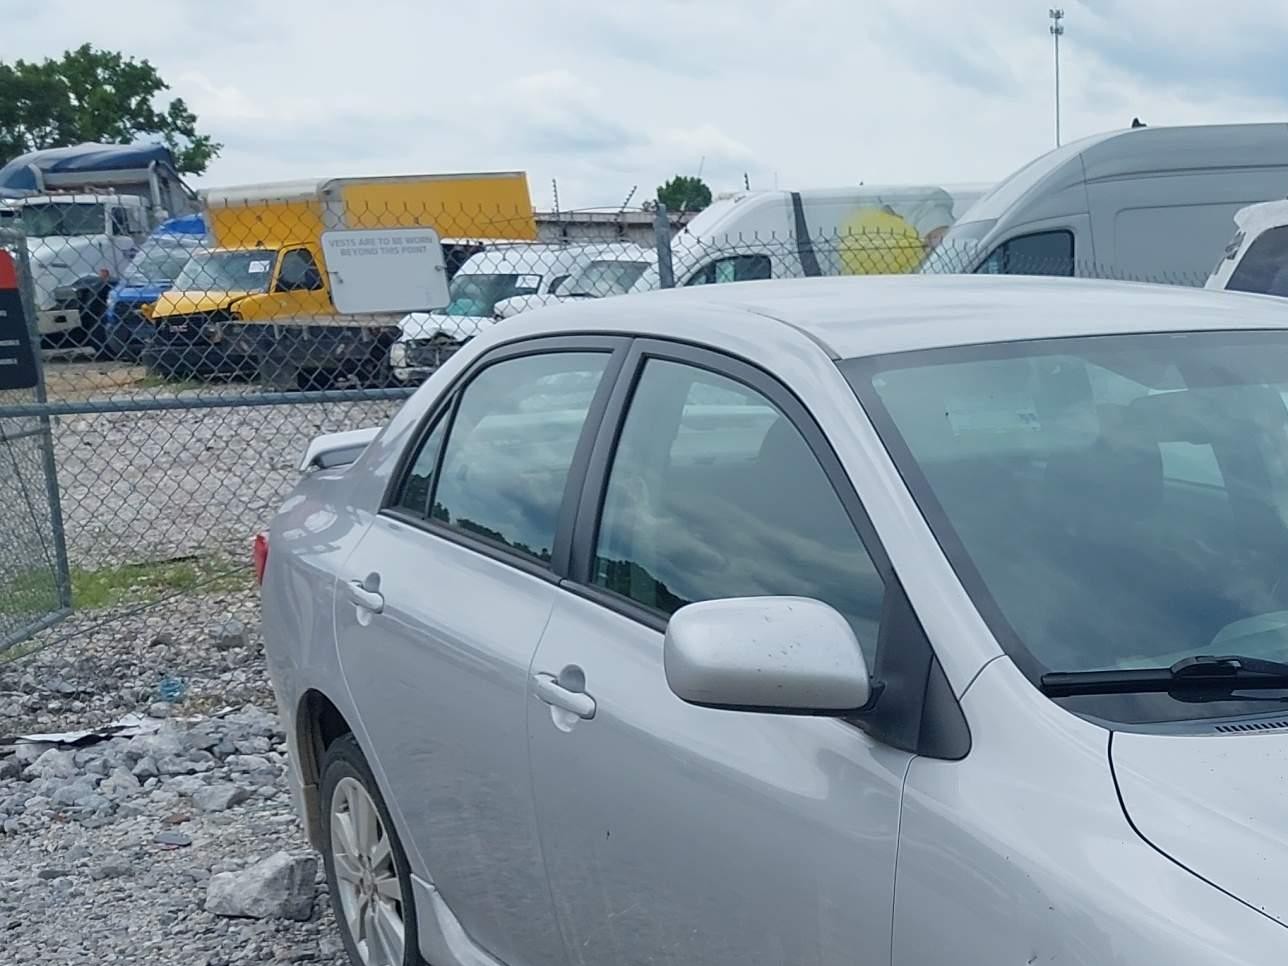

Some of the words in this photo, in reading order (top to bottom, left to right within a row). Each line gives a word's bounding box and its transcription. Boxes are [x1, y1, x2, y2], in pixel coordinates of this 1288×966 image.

[329, 239, 356, 248] VESTS
[359, 238, 376, 246] ARE
[392, 237, 403, 245] BE
[404, 236, 433, 244] WORN
[340, 248, 379, 256] BEYOND
[380, 247, 399, 256] THIS
[401, 246, 427, 254] POINT
